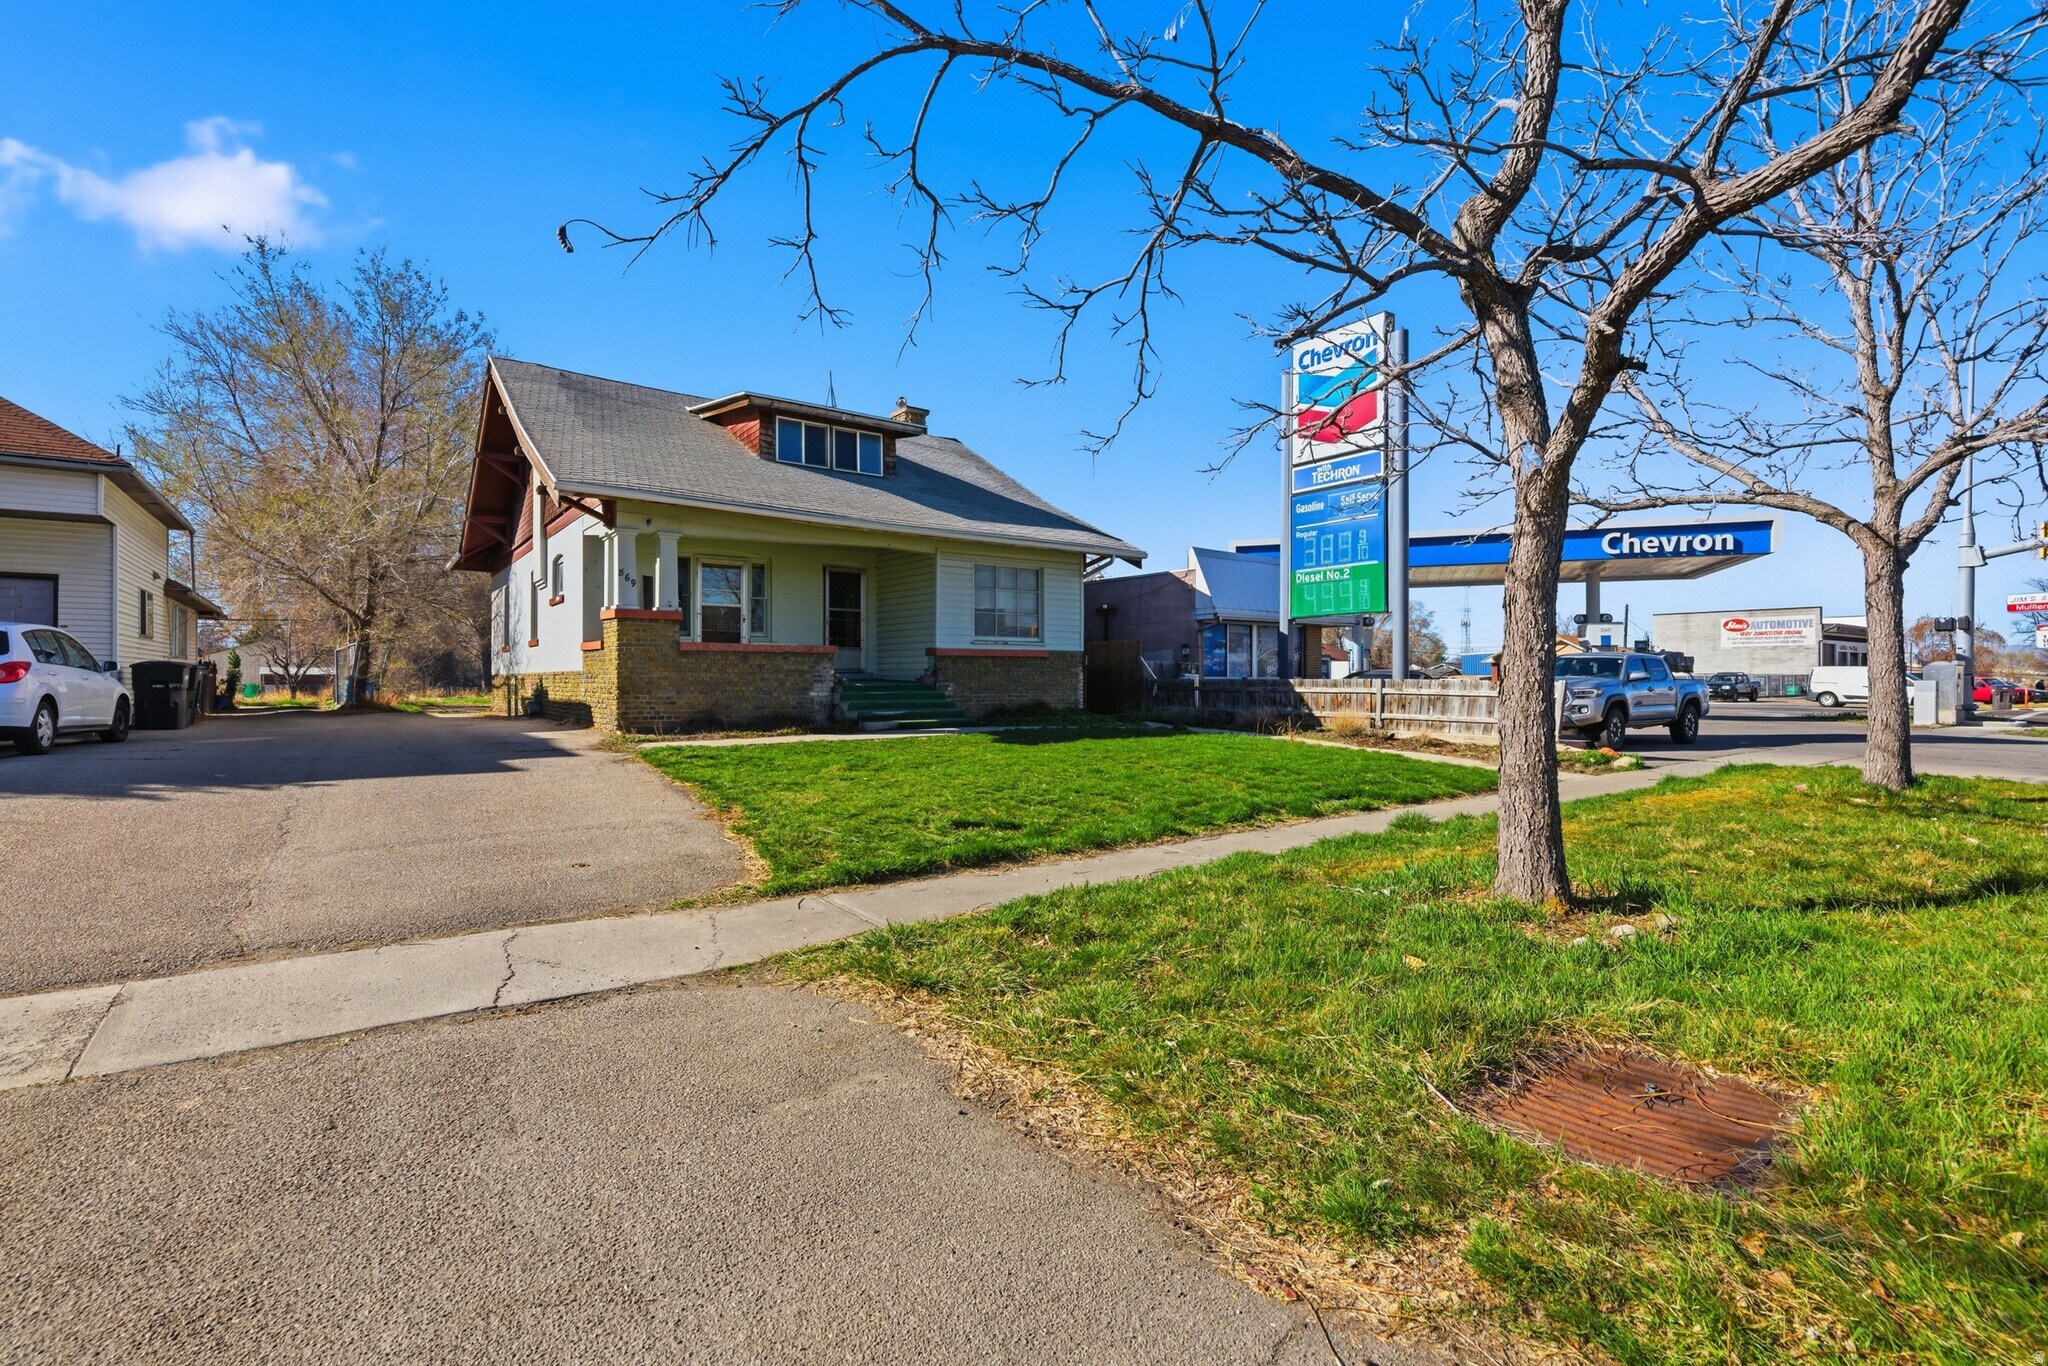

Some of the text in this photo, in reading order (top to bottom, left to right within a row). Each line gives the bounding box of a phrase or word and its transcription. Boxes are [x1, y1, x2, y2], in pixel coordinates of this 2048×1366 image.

[1299, 331, 1378, 370] Chevron
[1312, 464, 1360, 484] TECHRON
[1317, 463, 1332, 473] with
[1296, 501, 1325, 513] Gasoline
[1340, 493, 1355, 506] Self
[1296, 530, 1318, 539] Regular
[1601, 531, 1734, 554] Chevron
[618, 568, 637, 587] 869
[1296, 568, 1351, 583] Diesel No.2
[1750, 619, 1814, 630] AUTOMOTIVE
